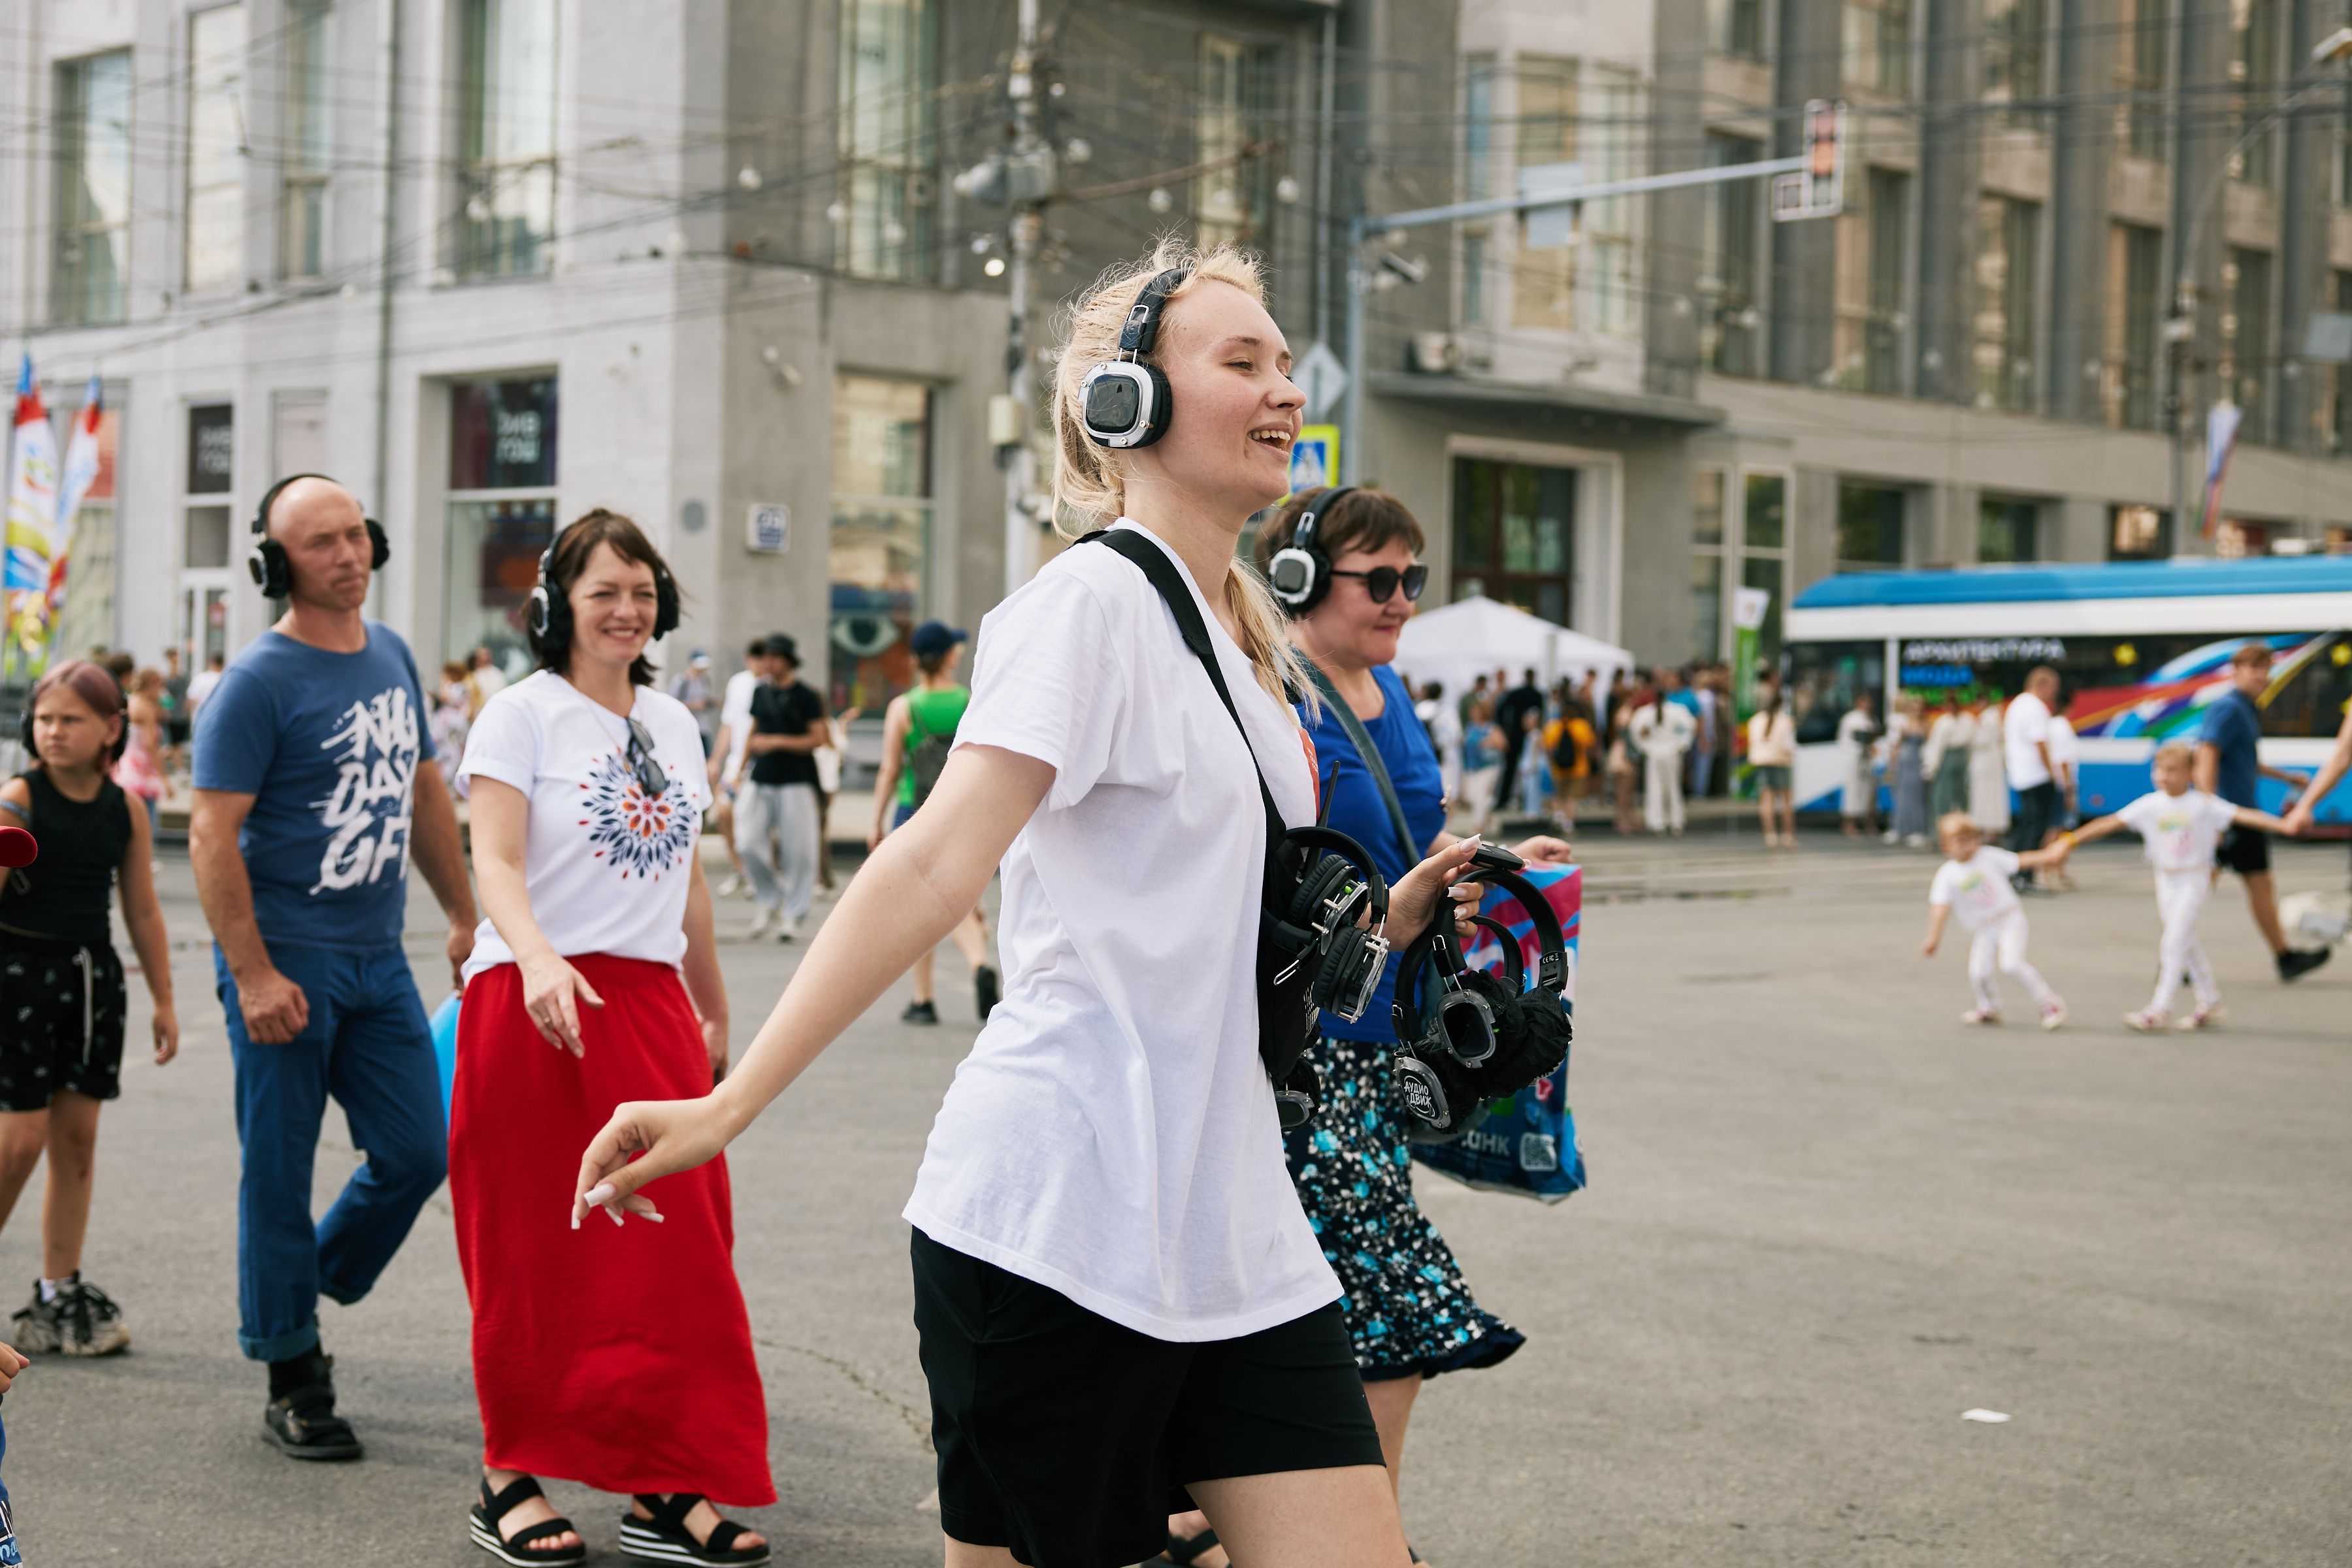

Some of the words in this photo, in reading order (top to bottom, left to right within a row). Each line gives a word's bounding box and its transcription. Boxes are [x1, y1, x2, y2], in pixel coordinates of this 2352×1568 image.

[1404, 1081, 1429, 1096] АУДИО
[1410, 1092, 1431, 1108] ДВИЖ
[1461, 1130, 1510, 1156] анк
